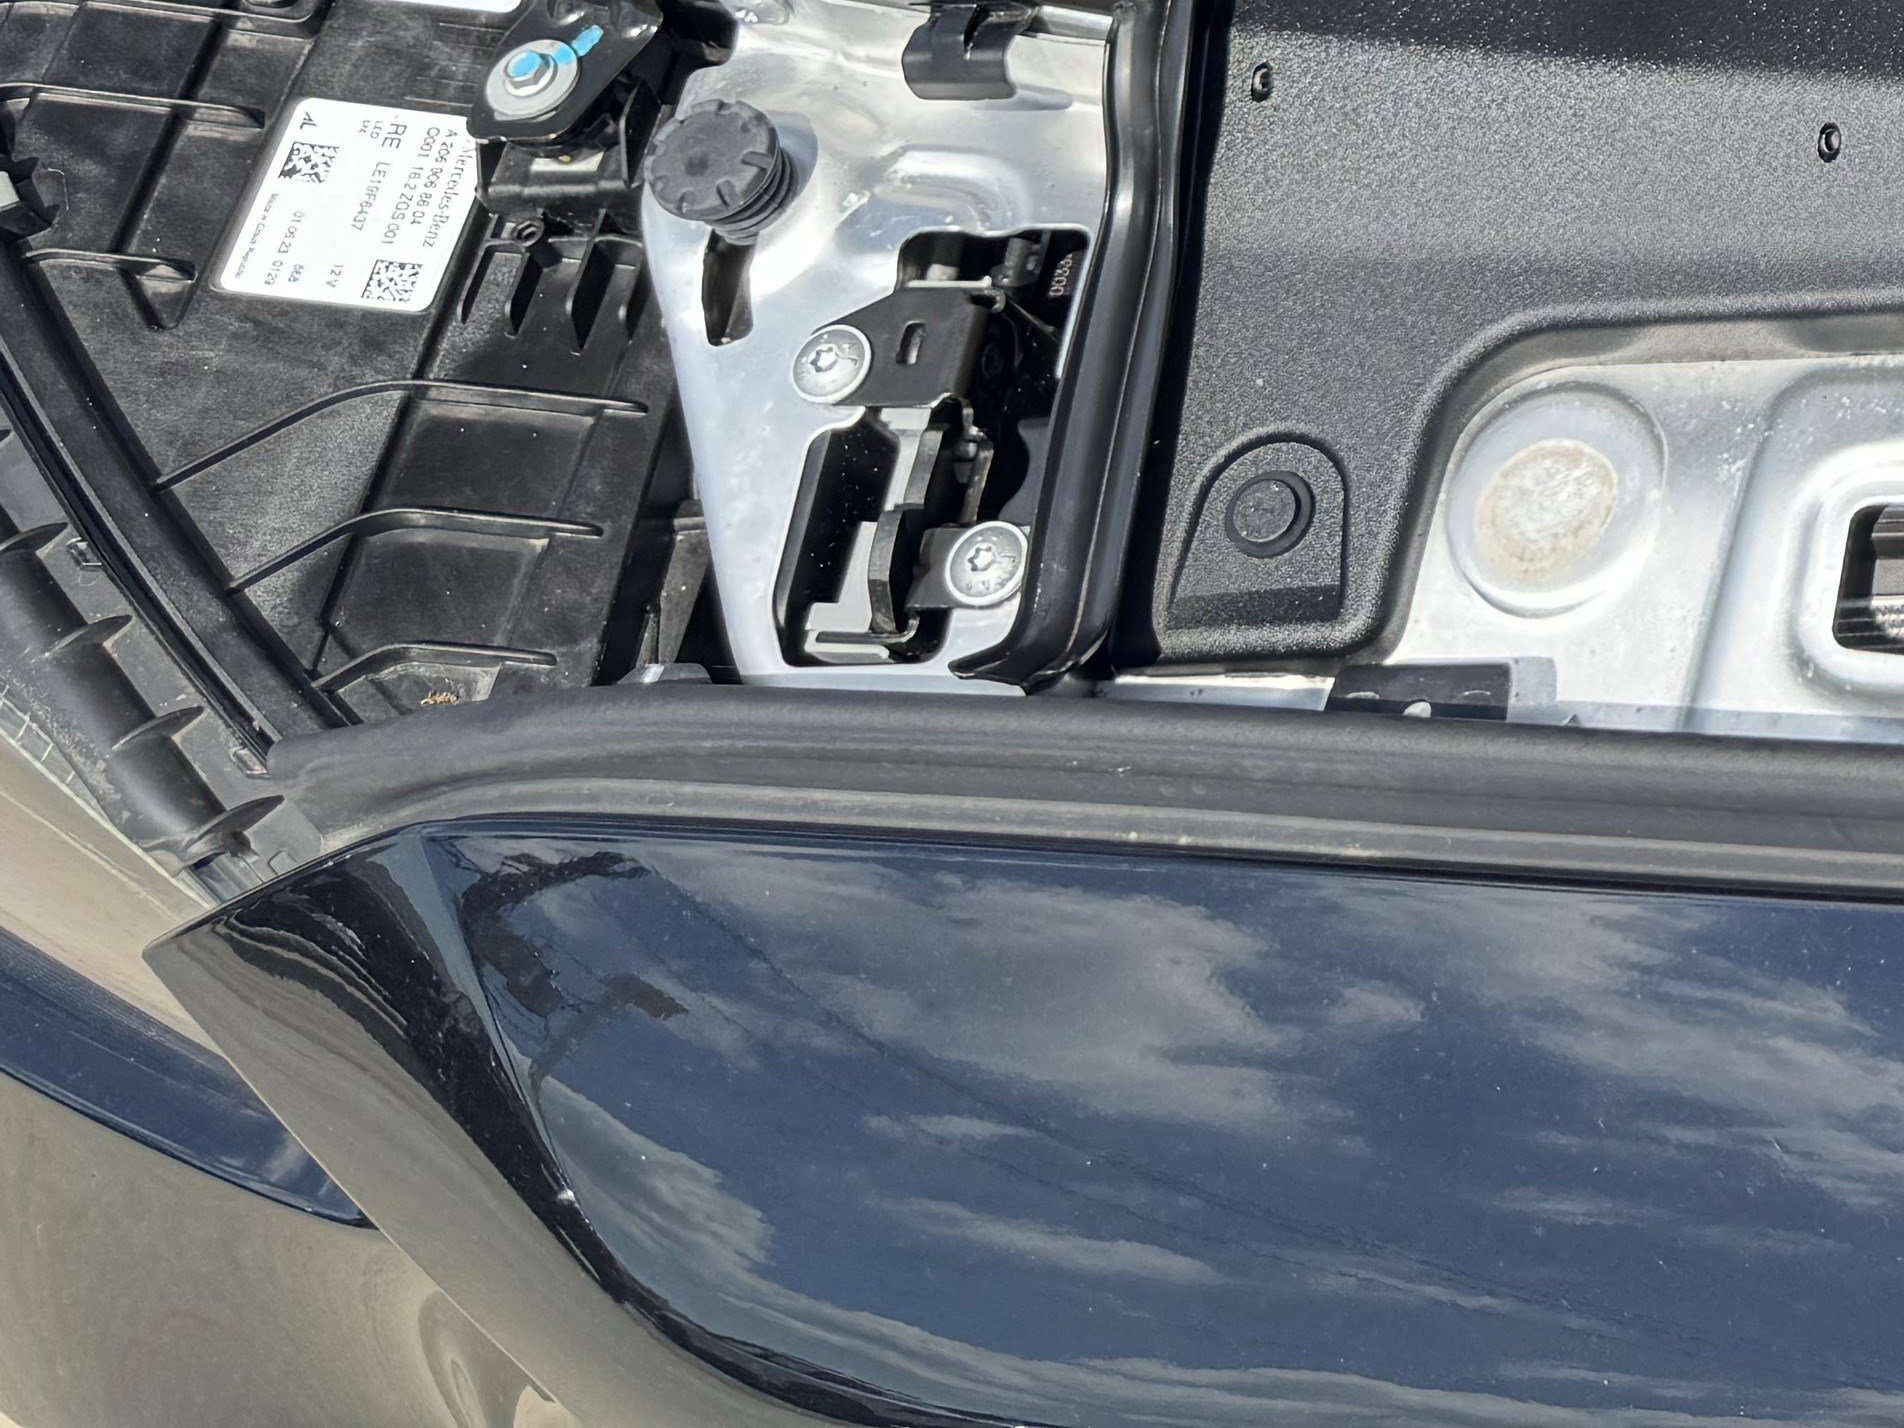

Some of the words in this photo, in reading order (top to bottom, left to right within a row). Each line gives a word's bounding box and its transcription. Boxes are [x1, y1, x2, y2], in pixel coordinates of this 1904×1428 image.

[381, 122, 408, 149] RE
[445, 129, 458, 138] A
[423, 141, 476, 248] Mercedes-Benz
